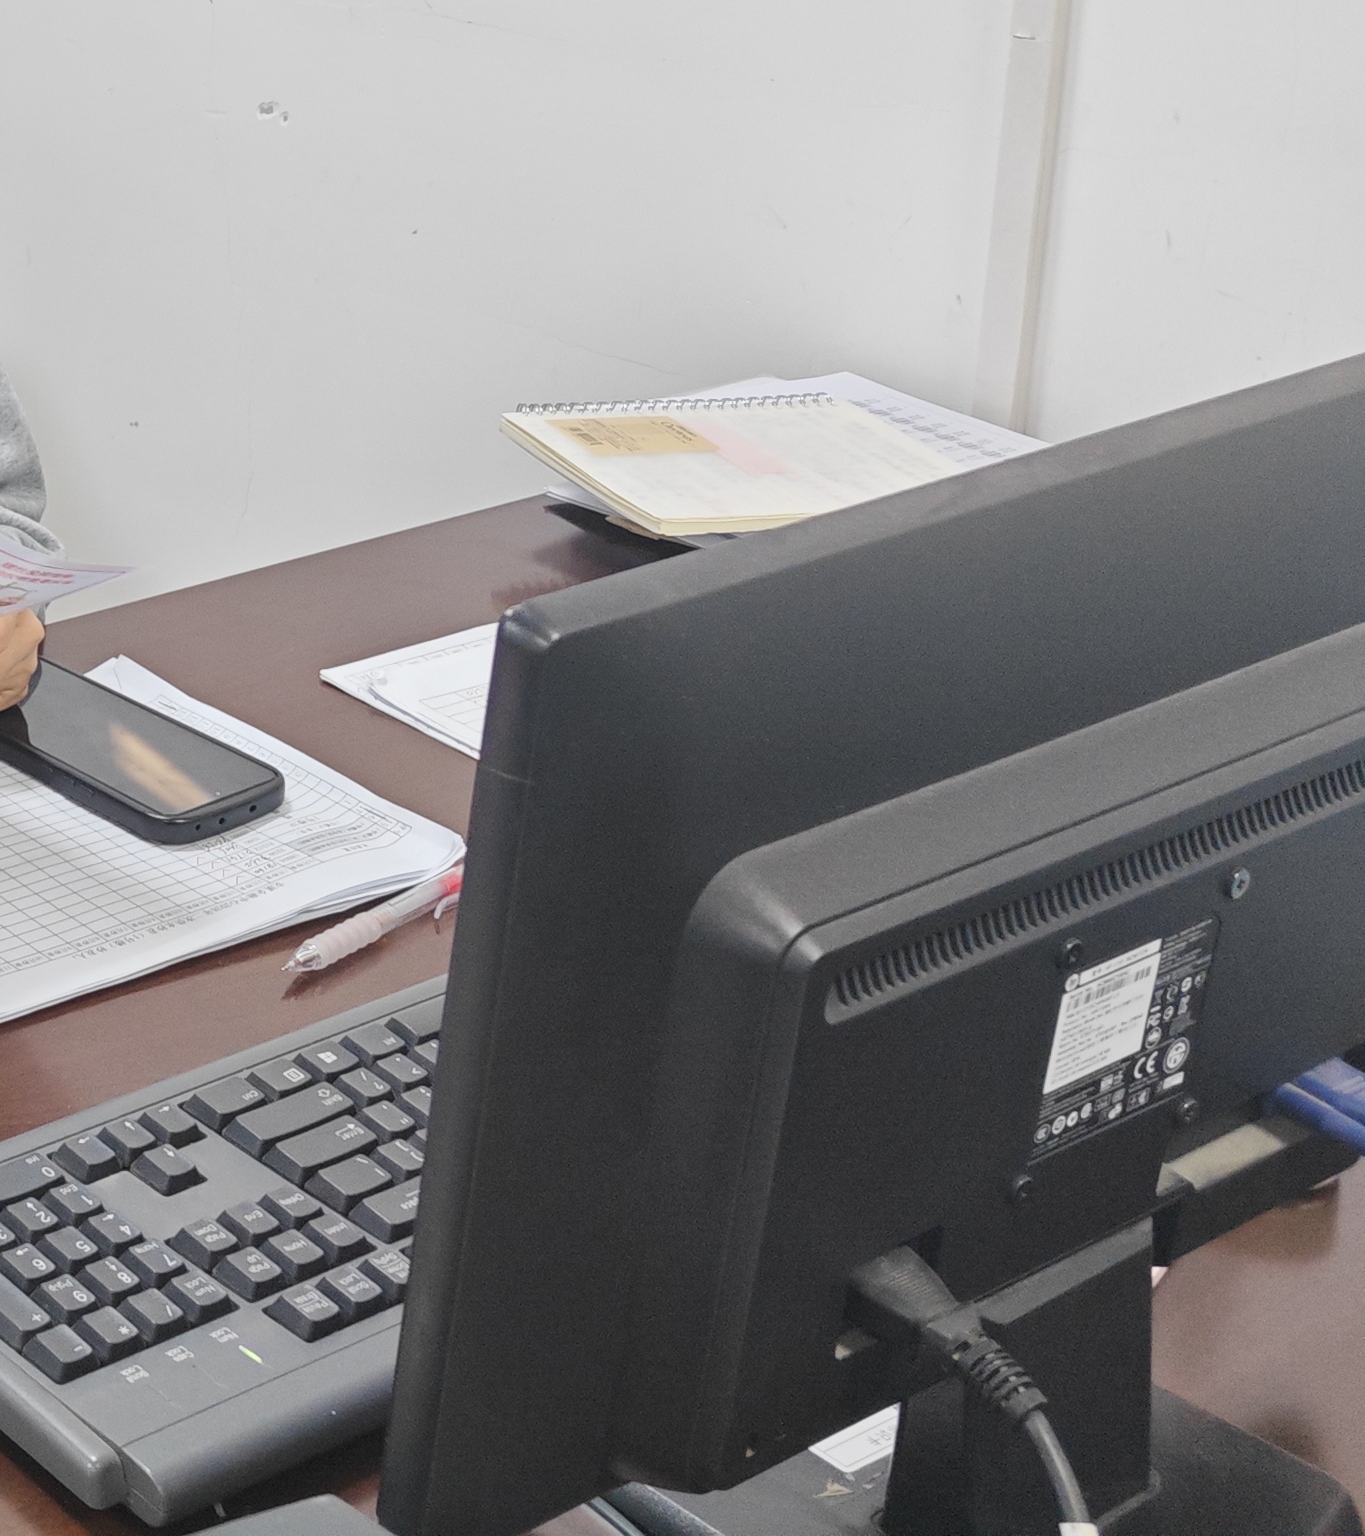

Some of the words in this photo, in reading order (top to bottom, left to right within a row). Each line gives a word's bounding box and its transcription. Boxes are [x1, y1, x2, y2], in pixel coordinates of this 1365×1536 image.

[41, 1166, 56, 1179] 0
[75, 1240, 92, 1253] 5
[31, 1257, 47, 1272] 6
[162, 1252, 178, 1267] 7
[116, 1270, 133, 1284] 8
[72, 1289, 88, 1303] 9
